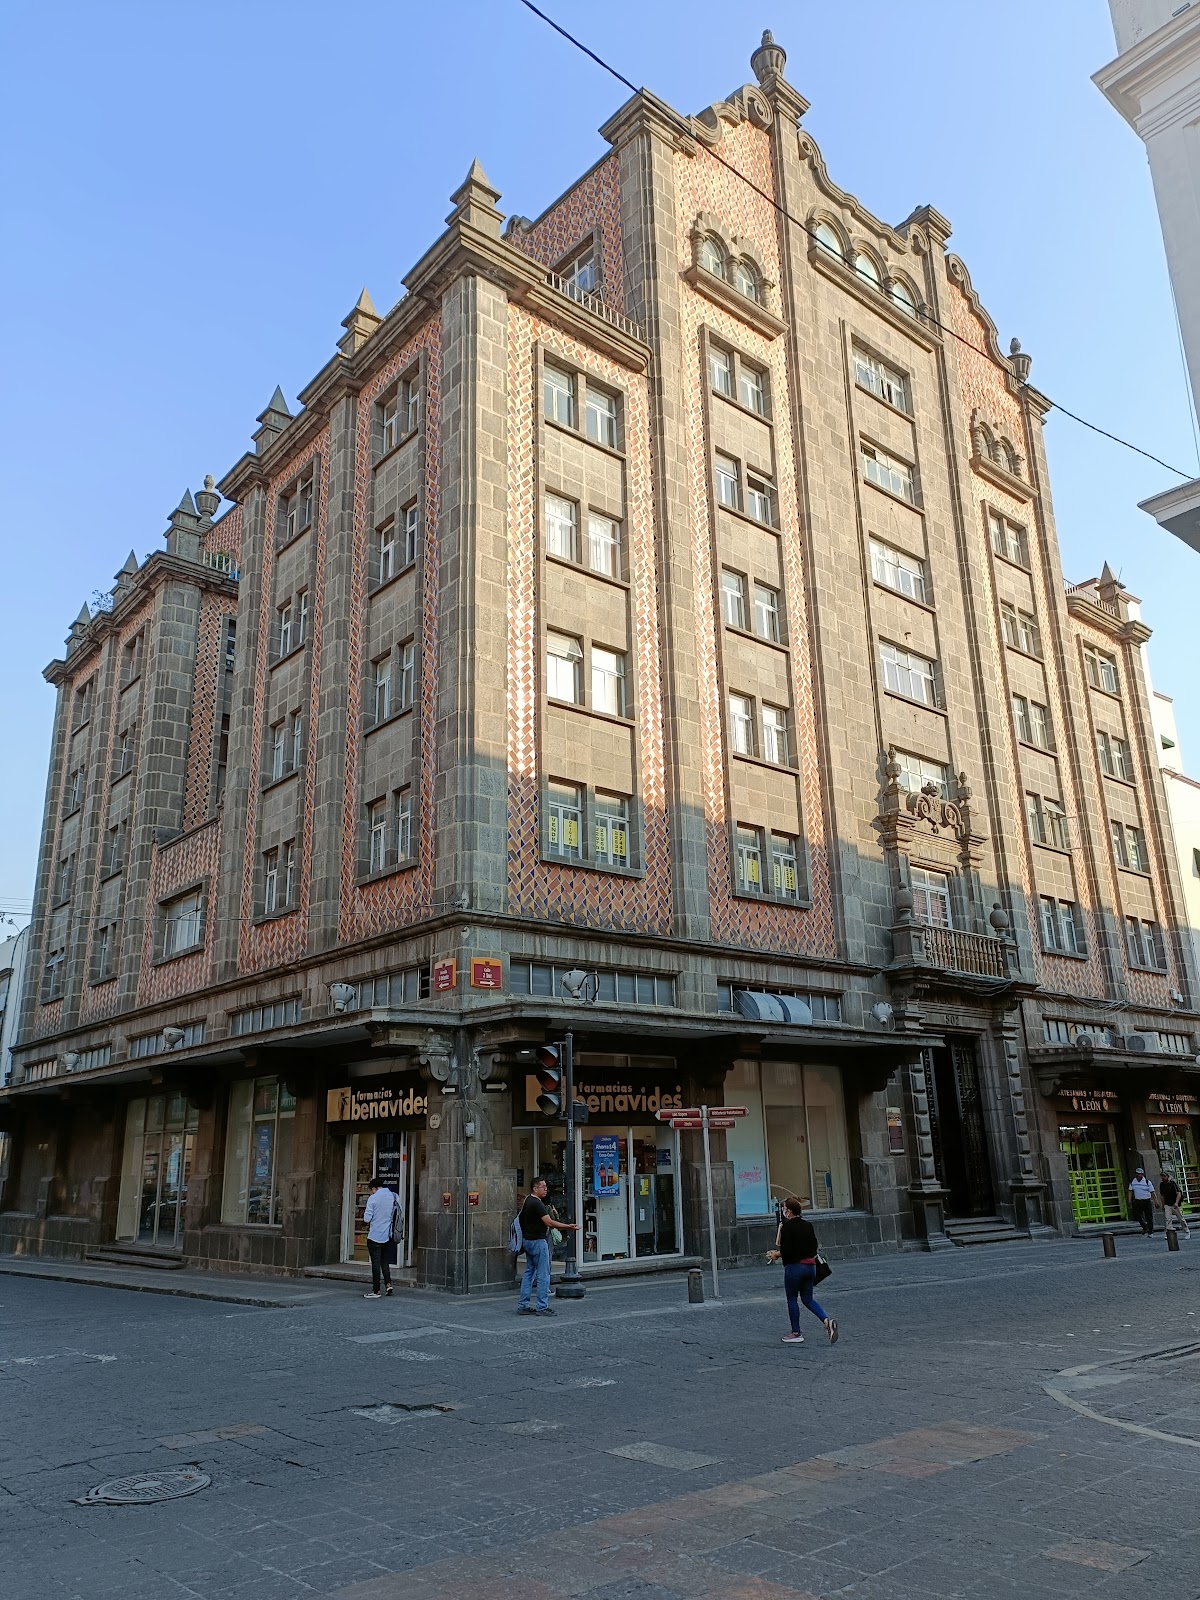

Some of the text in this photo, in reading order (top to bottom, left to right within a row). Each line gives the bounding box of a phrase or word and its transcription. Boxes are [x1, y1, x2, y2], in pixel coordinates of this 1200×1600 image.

[579, 1081, 633, 1093] farmacias
[356, 1087, 393, 1101] farmacias
[1080, 1098, 1101, 1111] LEÓN
[1166, 1101, 1183, 1113] LEÓN
